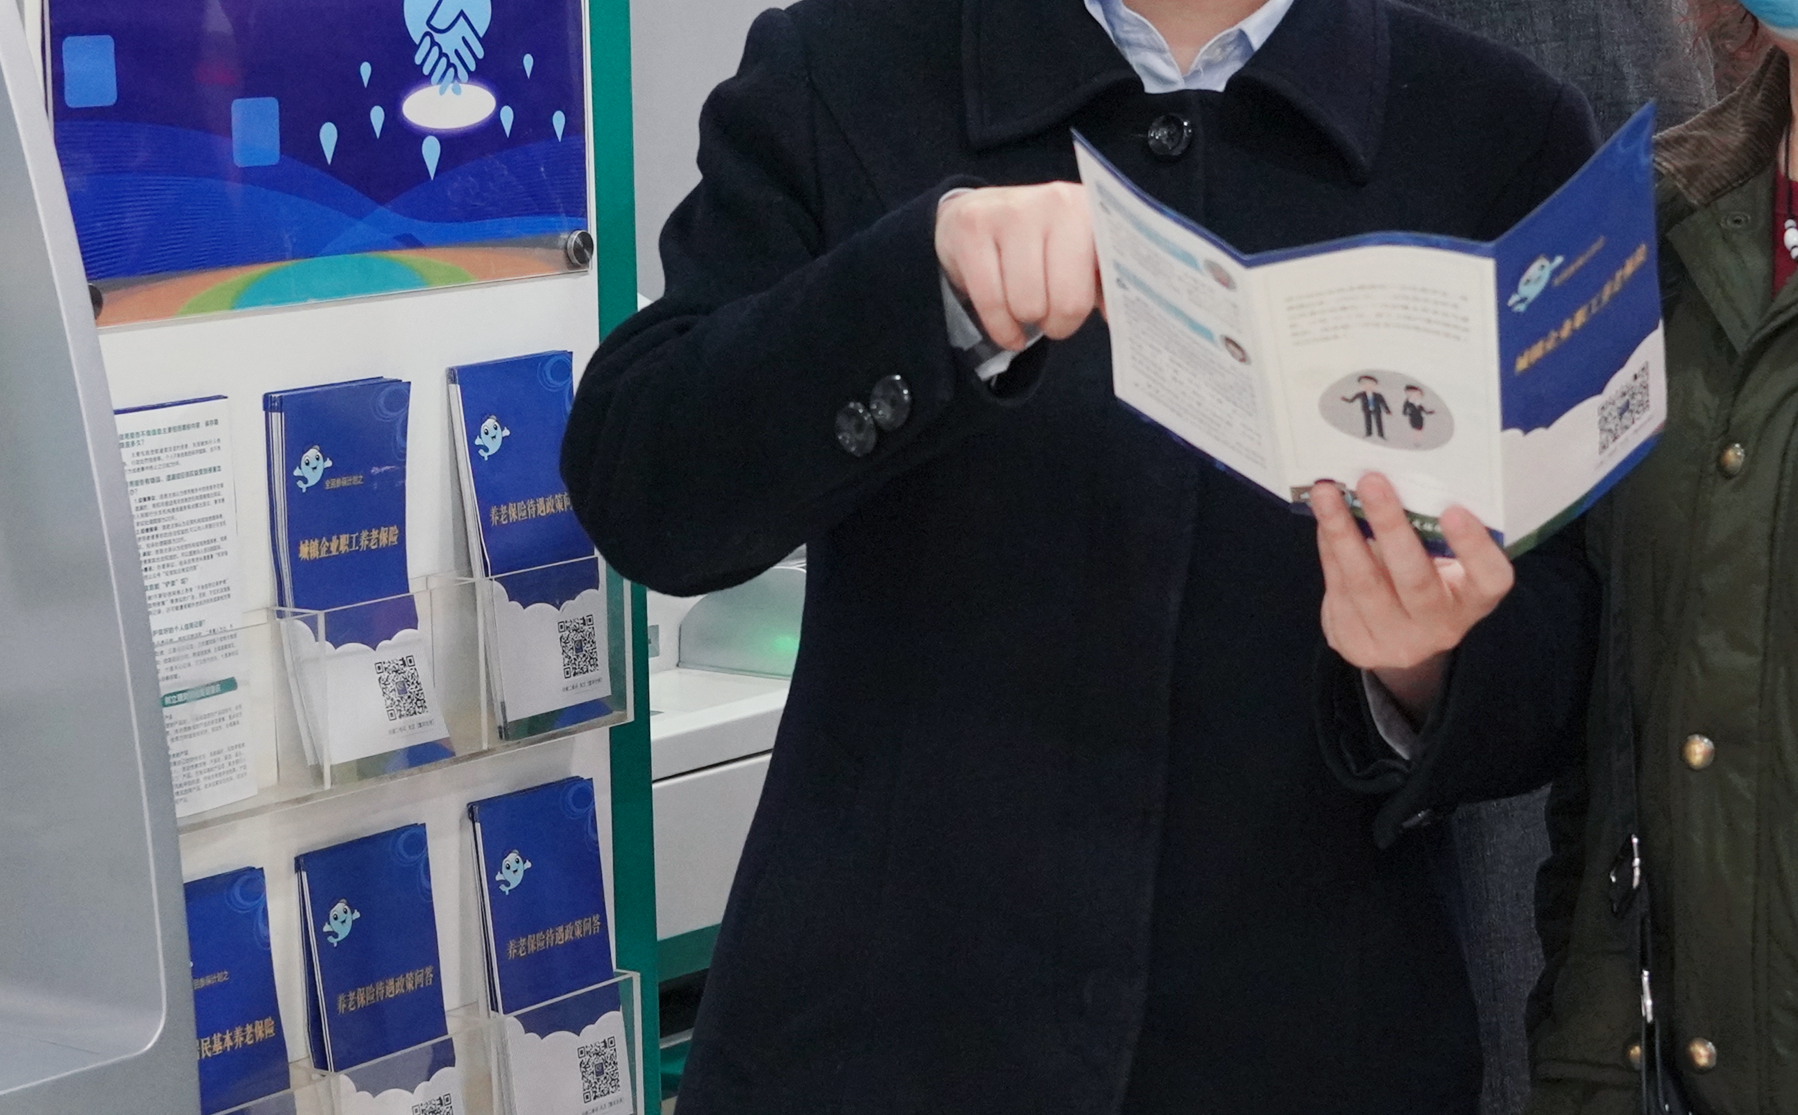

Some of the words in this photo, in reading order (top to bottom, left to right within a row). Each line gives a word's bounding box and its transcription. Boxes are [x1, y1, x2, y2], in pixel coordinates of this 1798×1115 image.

[298, 525, 400, 561] 城镇企业职工养老保险
[506, 913, 603, 961] 养老保险待遇政策问答
[336, 964, 436, 1016] 养老保险待遇政策问答
